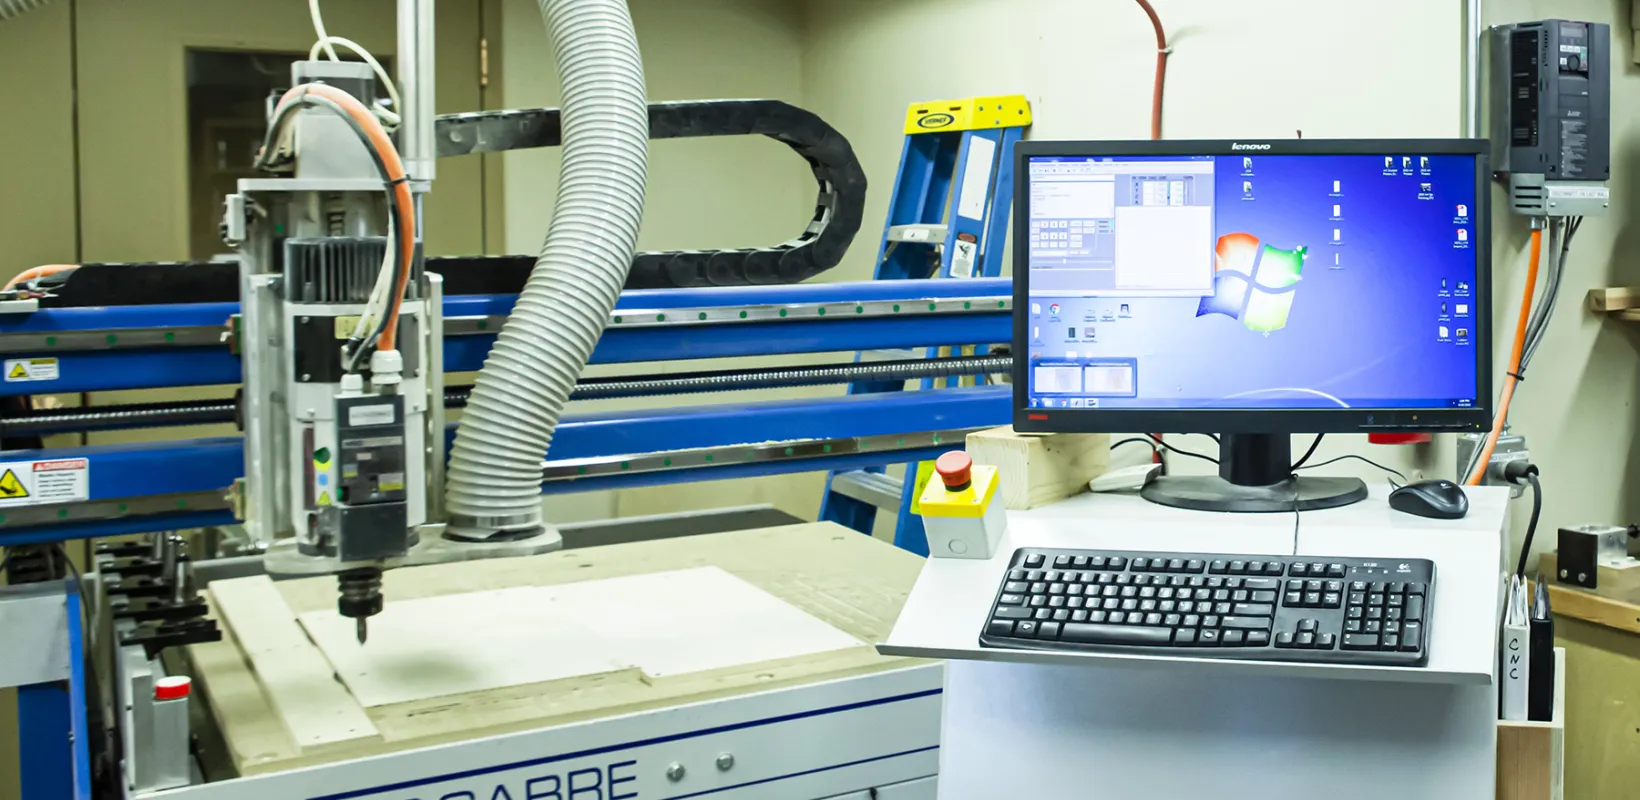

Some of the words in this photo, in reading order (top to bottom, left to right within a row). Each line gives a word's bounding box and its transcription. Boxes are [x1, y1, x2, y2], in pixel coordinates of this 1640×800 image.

[1231, 142, 1271, 151] lenovo
[1508, 638, 1520, 680] CNC
[440, 759, 639, 800] BRE
